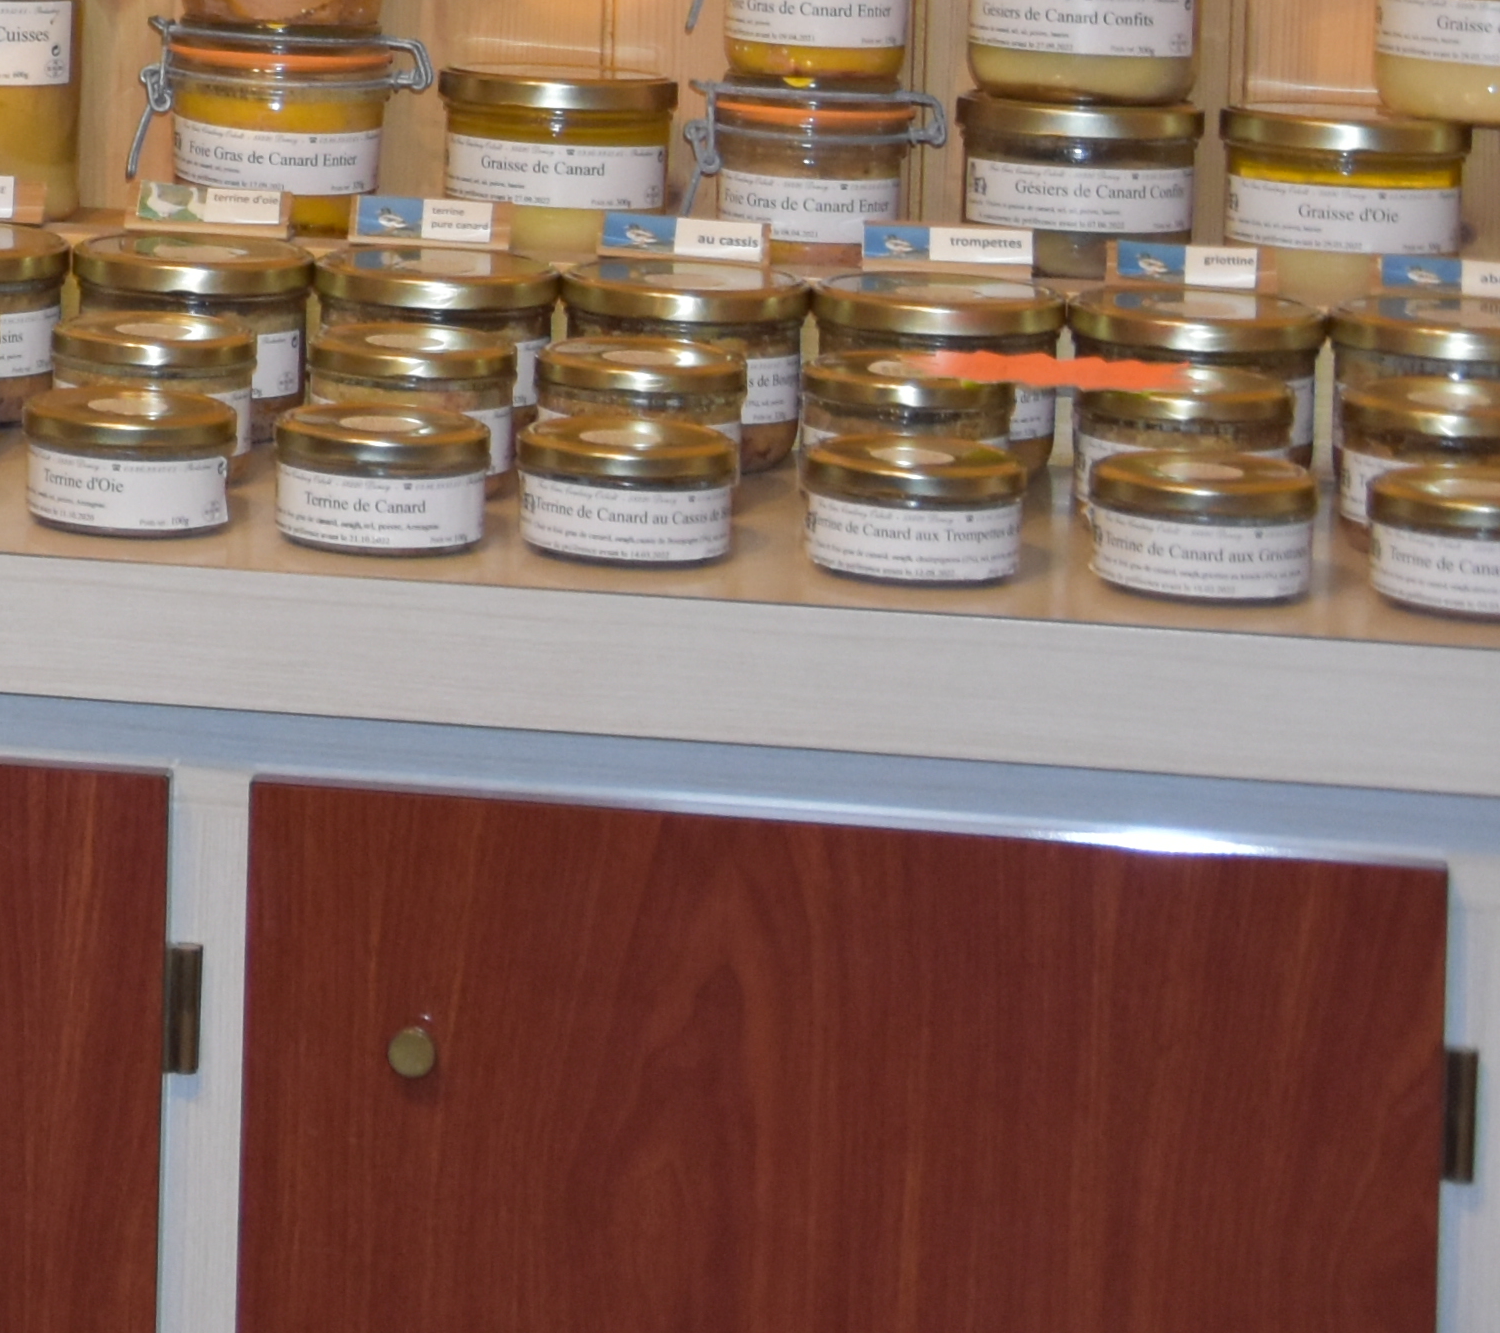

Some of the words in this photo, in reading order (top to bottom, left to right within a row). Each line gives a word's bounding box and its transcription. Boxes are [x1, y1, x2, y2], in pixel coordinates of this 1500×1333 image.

[1024, 6, 1040, 21] de
[1045, 8, 1098, 25] Canard
[1102, 10, 1153, 27] Confits
[481, 154, 528, 172] Graisse
[532, 159, 549, 174] de
[554, 160, 605, 176] Canard
[1298, 203, 1354, 221] Graisse
[697, 235, 715, 244] au
[719, 233, 759, 249] cassis
[950, 237, 1022, 250] trompettes
[1204, 254, 1255, 269] griottine
[304, 491, 348, 510] Terrine
[353, 498, 370, 512] de
[375, 497, 425, 514] Canard
